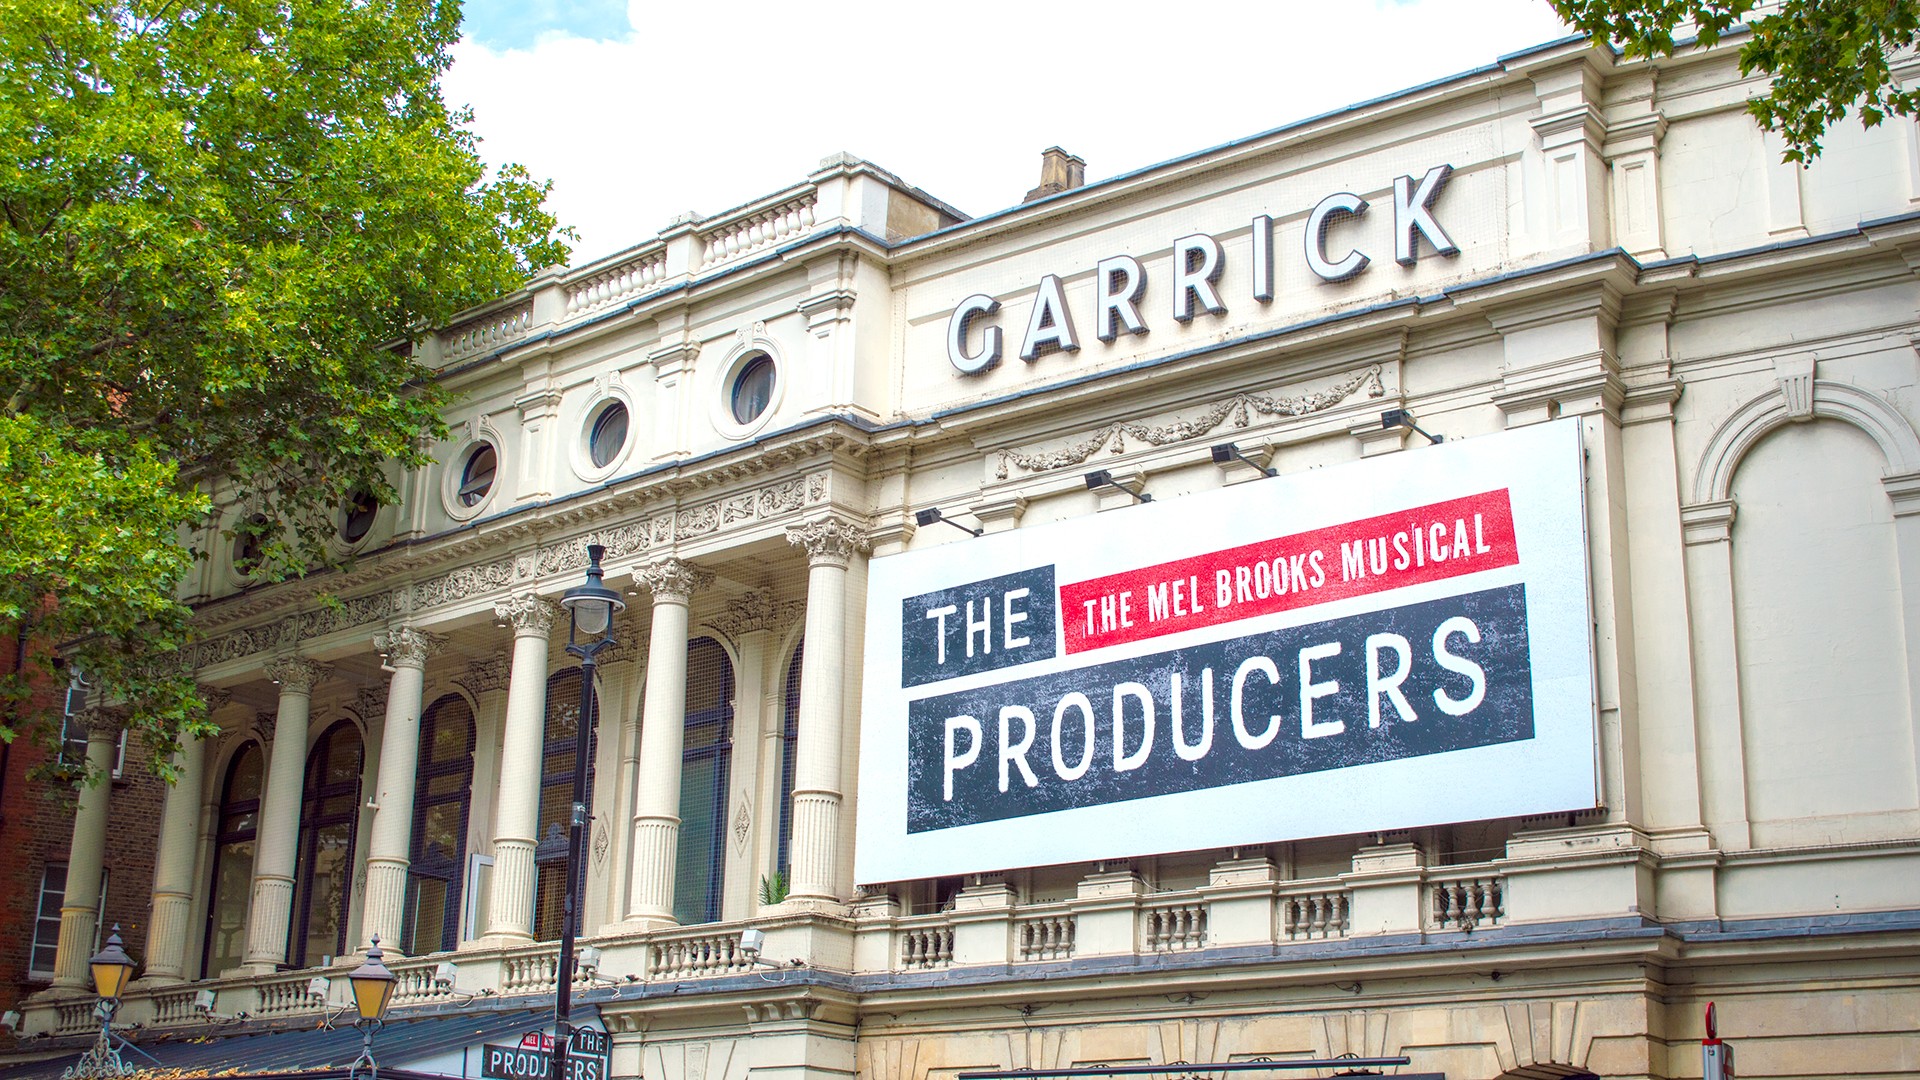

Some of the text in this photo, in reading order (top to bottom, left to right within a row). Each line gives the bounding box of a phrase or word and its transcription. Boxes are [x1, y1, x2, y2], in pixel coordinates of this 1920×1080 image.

[947, 163, 1461, 374] GARRICK
[926, 587, 1031, 665] THE
[1082, 513, 1491, 638] THE MEL BROOKS MUSICAL
[942, 616, 1487, 801] PRODUCERS
[580, 1034, 604, 1052] THE
